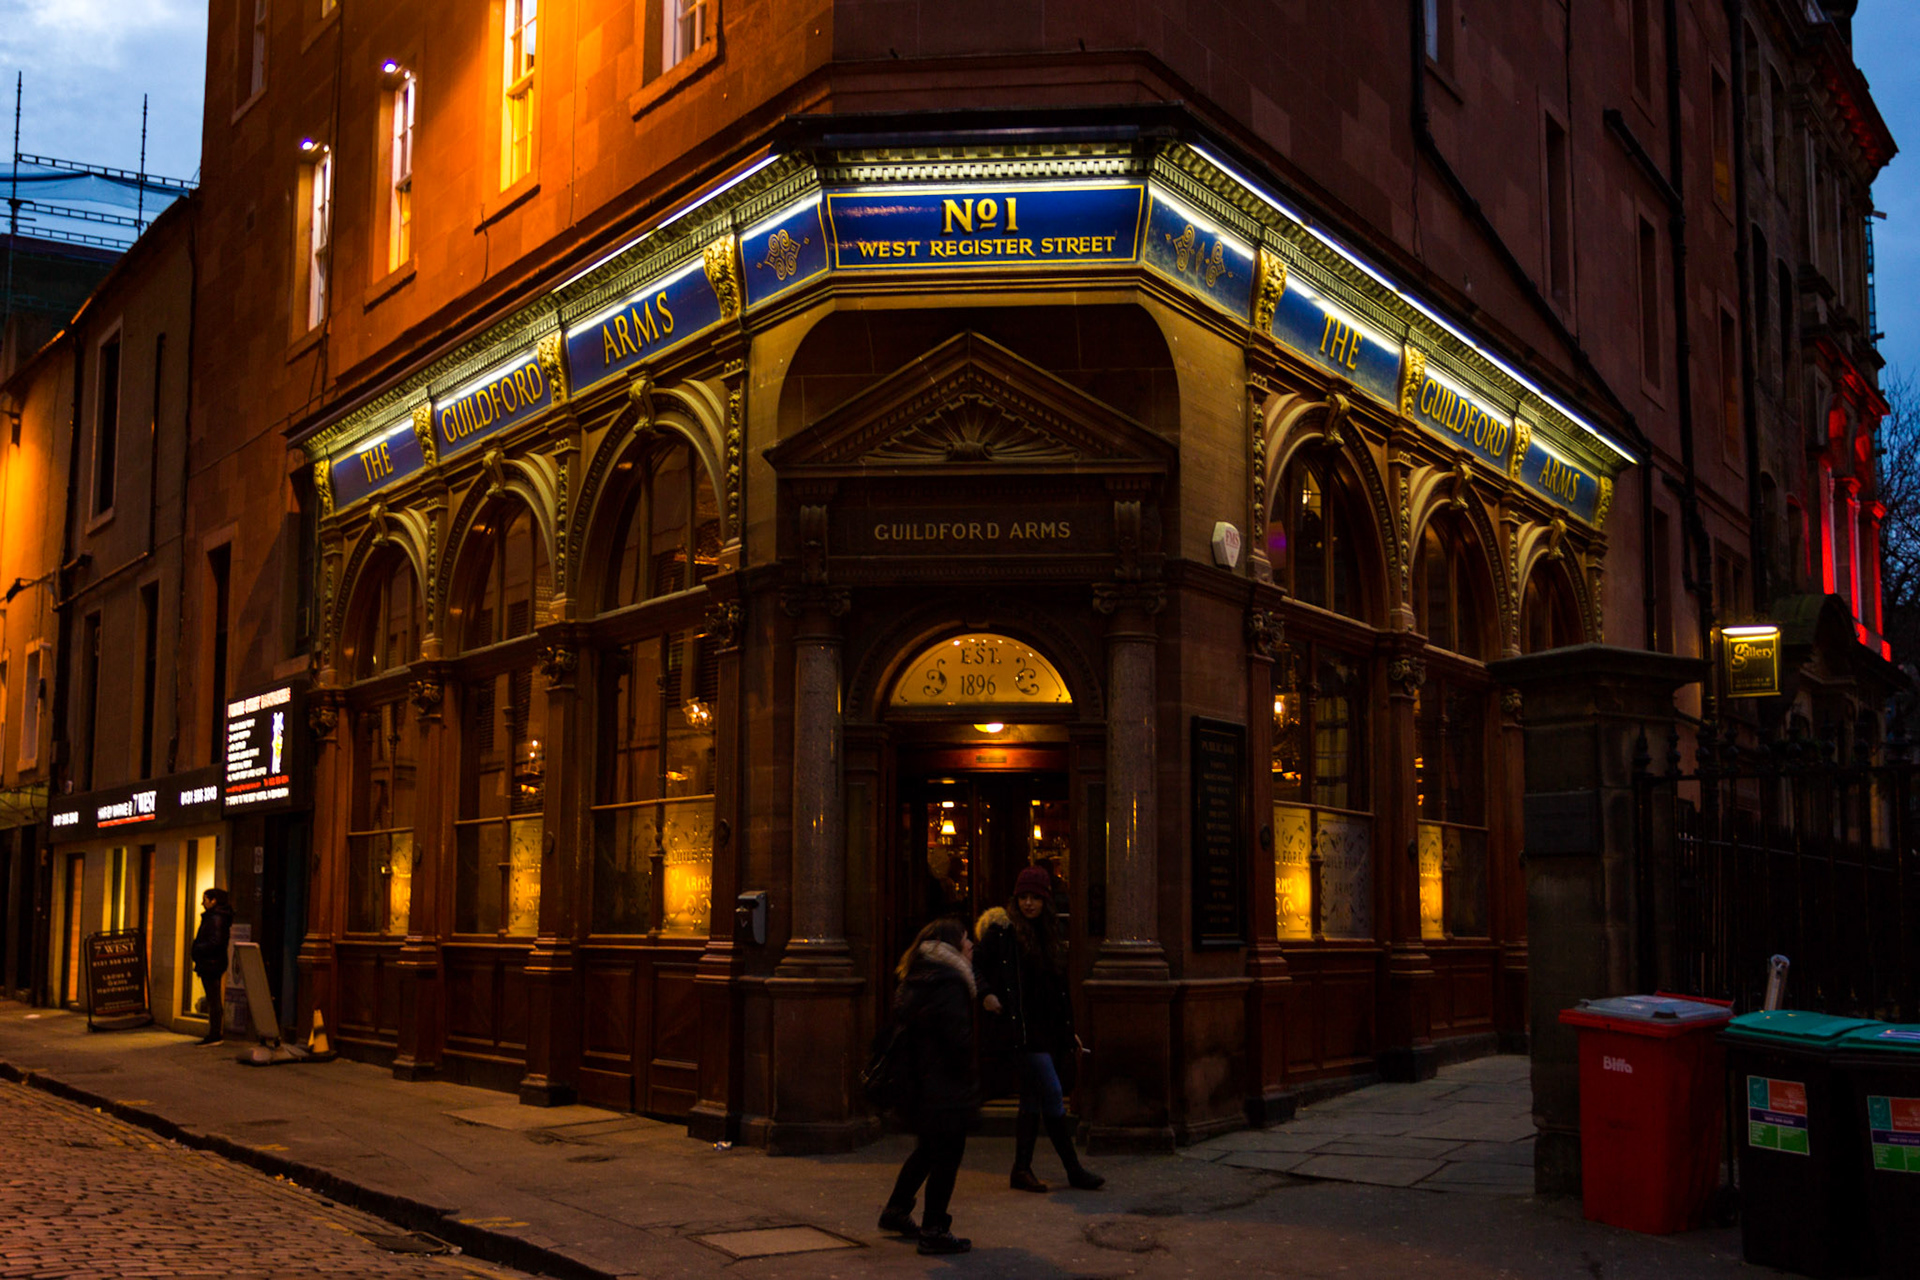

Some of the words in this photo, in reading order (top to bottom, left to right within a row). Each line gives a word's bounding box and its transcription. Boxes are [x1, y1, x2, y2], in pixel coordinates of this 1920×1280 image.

[857, 241, 921, 258] WEST
[929, 238, 1036, 257] REGISTER
[1041, 236, 1116, 255] STREET
[360, 441, 394, 485] THE
[441, 362, 544, 444] GUILDFORD
[602, 291, 675, 366] ARMS
[1320, 311, 1363, 372] THE
[1419, 378, 1509, 458] GUILDFORD
[1538, 456, 1581, 504] ARMS
[873, 522, 1000, 541] GUILDFORD
[1008, 521, 1072, 540] ARMS
[960, 674, 997, 696] 1896
[103, 942, 135, 955] WEST
[1602, 1055, 1633, 1074] Biffa
